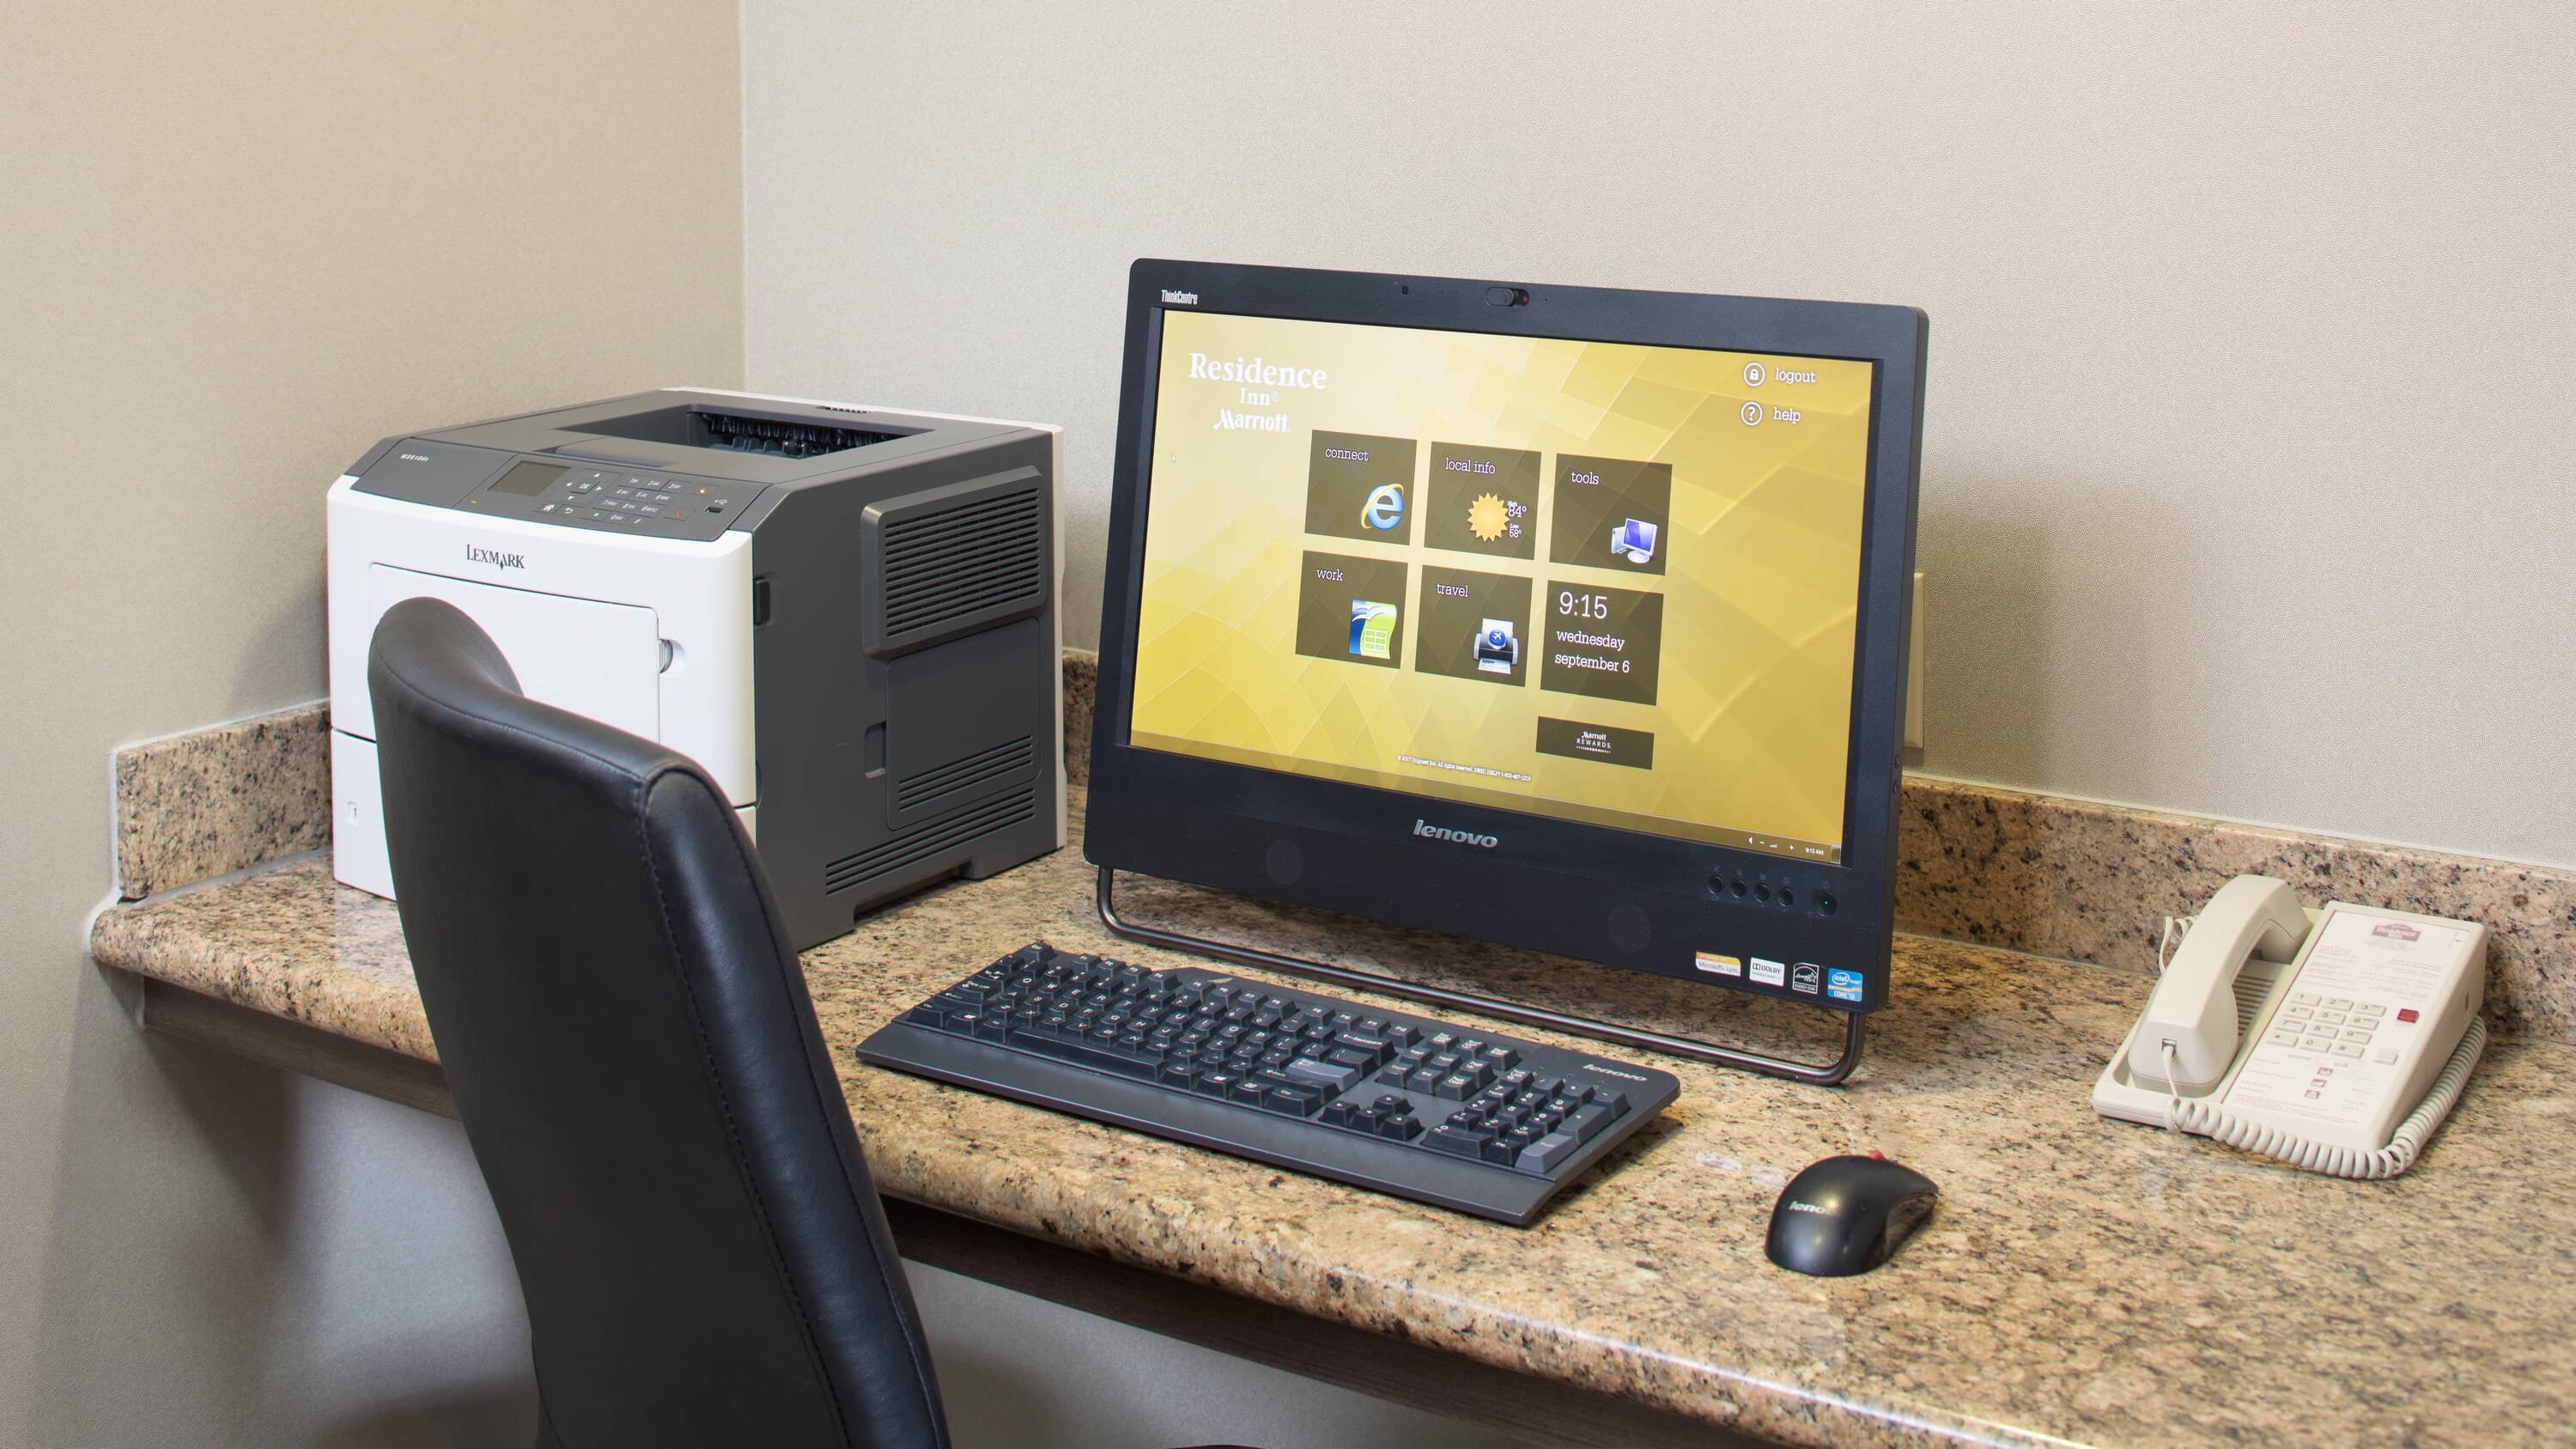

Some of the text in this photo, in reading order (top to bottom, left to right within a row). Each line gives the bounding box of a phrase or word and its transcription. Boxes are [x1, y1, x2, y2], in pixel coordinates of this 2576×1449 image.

[1161, 289, 1198, 305] ThinkCentre
[1188, 351, 1327, 390] Residence
[1775, 367, 1816, 384] logout
[1212, 408, 1291, 433] Marriott
[1773, 406, 1801, 424] help
[1325, 447, 1369, 461] connect
[1445, 457, 1496, 474] local info
[1571, 471, 1600, 485] tools
[466, 544, 526, 570] LEXMARK
[1316, 569, 1344, 581] work
[1436, 582, 1469, 597] travel
[1559, 591, 1607, 619] 9:15
[1556, 630, 1625, 652] wednesday
[1554, 654, 1630, 673] september 6
[1582, 731, 1607, 740] Marriott
[1413, 819, 1498, 848] lenovo
[1761, 965, 1781, 973] DOLBY
[1583, 1063, 1648, 1081] lenovo
[1789, 1201, 1838, 1216] leno
